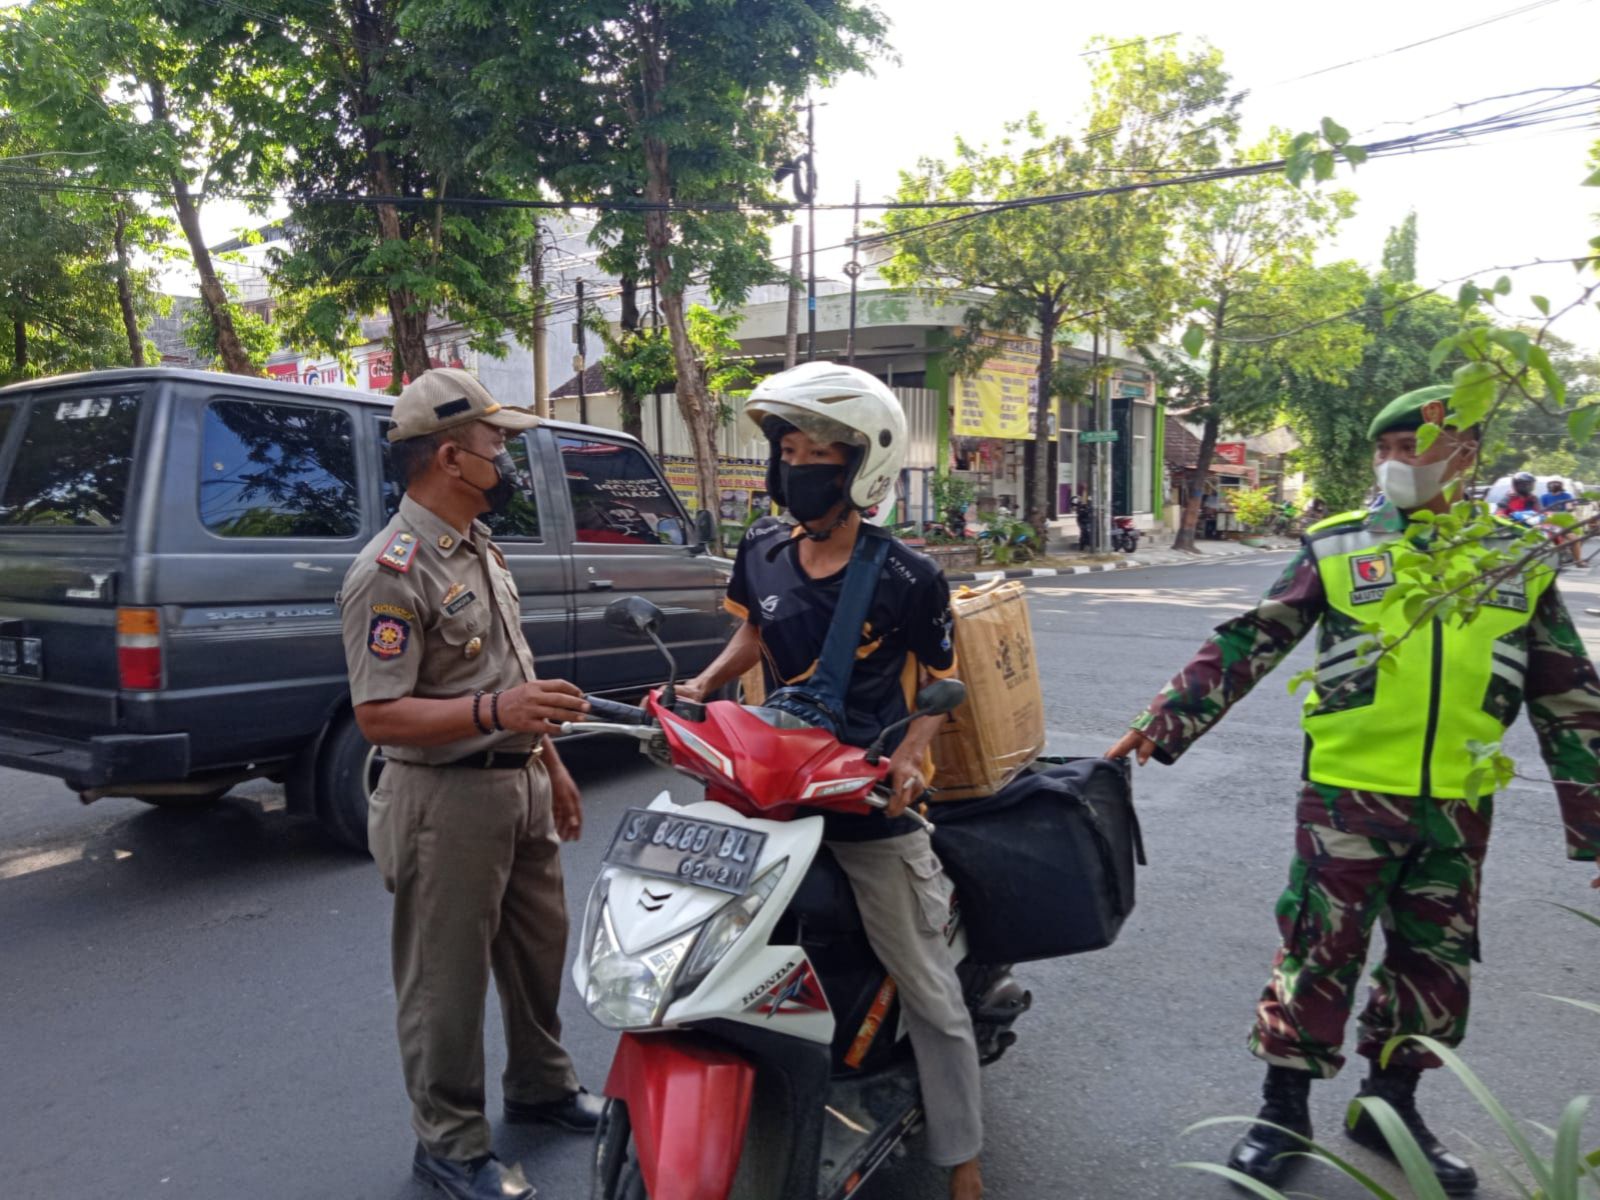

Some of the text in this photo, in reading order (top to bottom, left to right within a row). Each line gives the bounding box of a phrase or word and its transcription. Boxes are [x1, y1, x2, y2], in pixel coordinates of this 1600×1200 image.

[625, 816, 643, 841] S
[718, 835, 749, 863] BL
[741, 960, 796, 1005] HONDA
